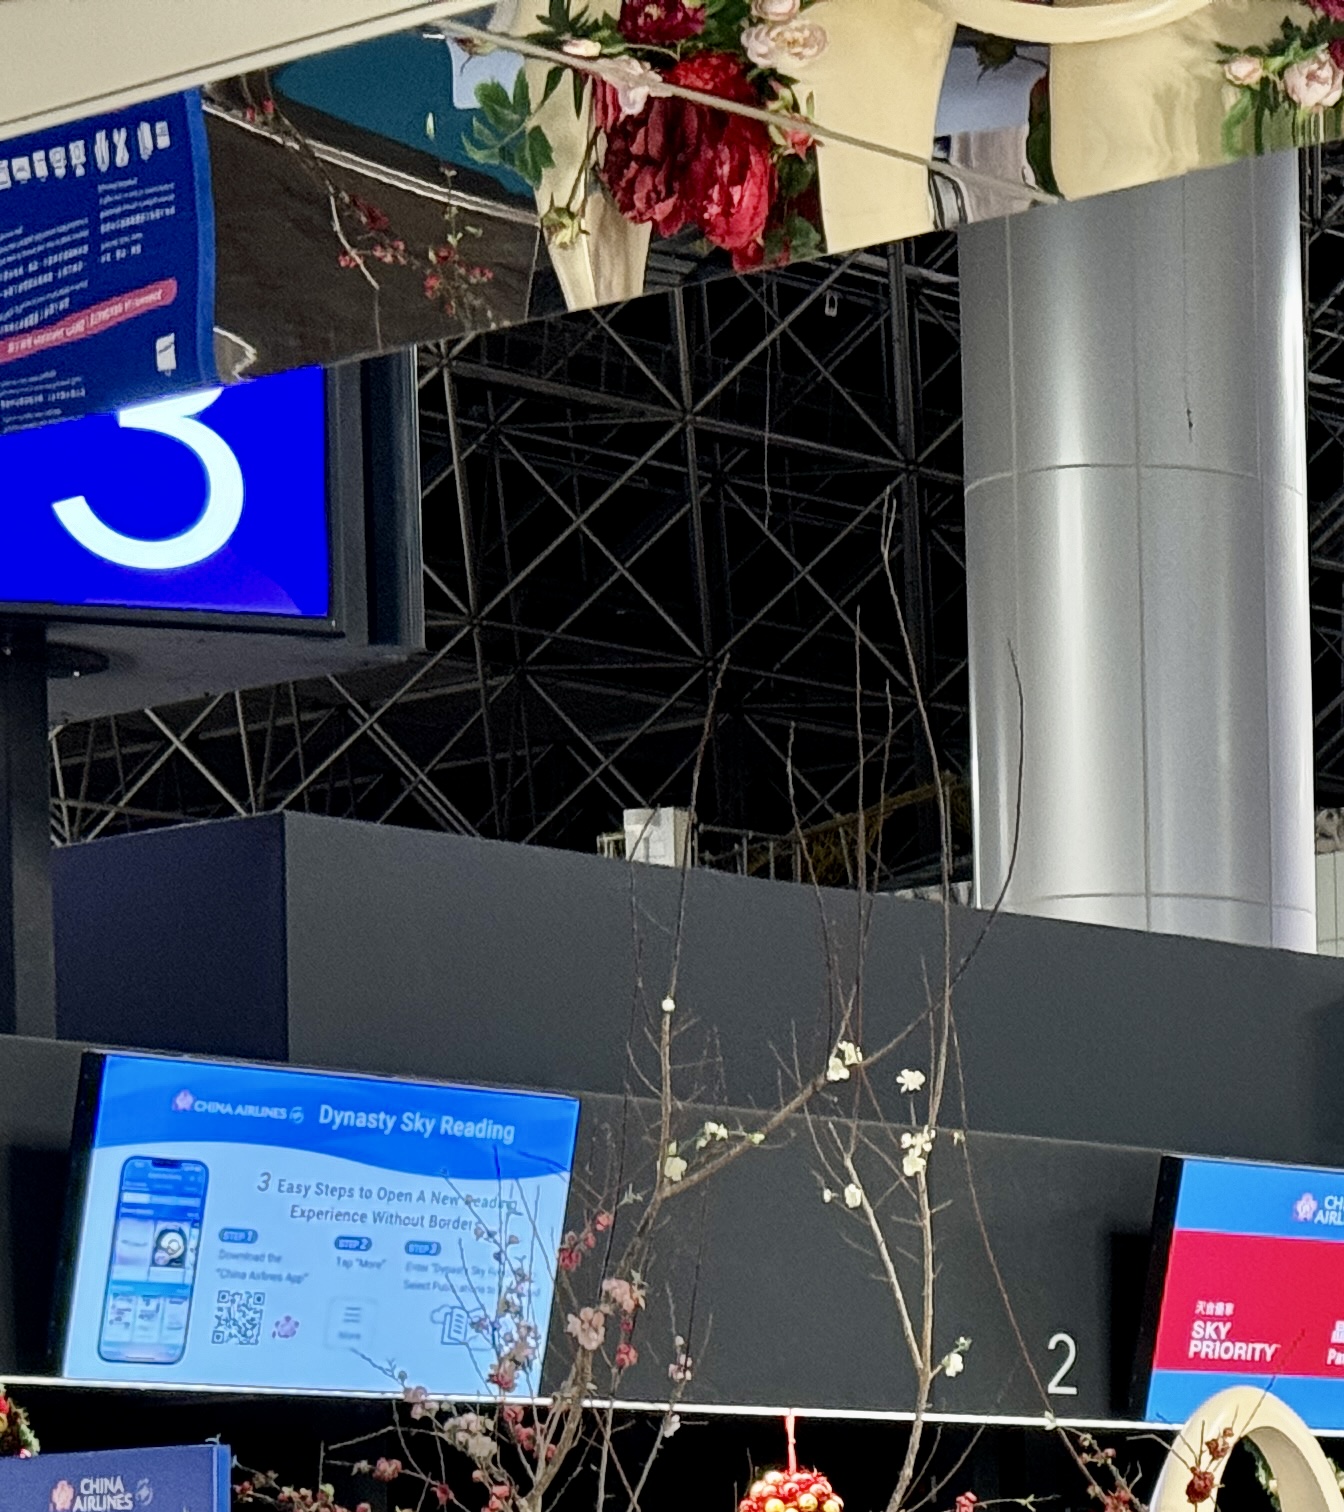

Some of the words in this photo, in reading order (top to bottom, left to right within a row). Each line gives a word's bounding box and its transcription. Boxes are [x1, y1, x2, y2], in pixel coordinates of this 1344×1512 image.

[194, 1099, 232, 1115] CHINA
[233, 1102, 288, 1120] AIRLINES
[319, 1104, 397, 1135] Dynasty
[400, 1111, 436, 1138] Sky
[440, 1115, 516, 1145] Reading
[257, 1172, 272, 1192] 3
[278, 1180, 310, 1198] Easy
[314, 1181, 355, 1200] Steps
[359, 1185, 373, 1200] to
[377, 1187, 413, 1205] Open
[416, 1190, 426, 1203] A
[430, 1191, 459, 1206] New
[290, 1205, 368, 1226] Experience
[372, 1210, 426, 1228] Without
[429, 1214, 480, 1233] Border
[222, 1231, 246, 1241] STEP
[338, 1239, 360, 1249] STEP
[408, 1243, 429, 1254] STEP
[1191, 1320, 1232, 1340] SKY
[1188, 1340, 1278, 1362] PRIORITY
[1047, 1333, 1077, 1395] 2
[80, 1476, 124, 1495] CHINA
